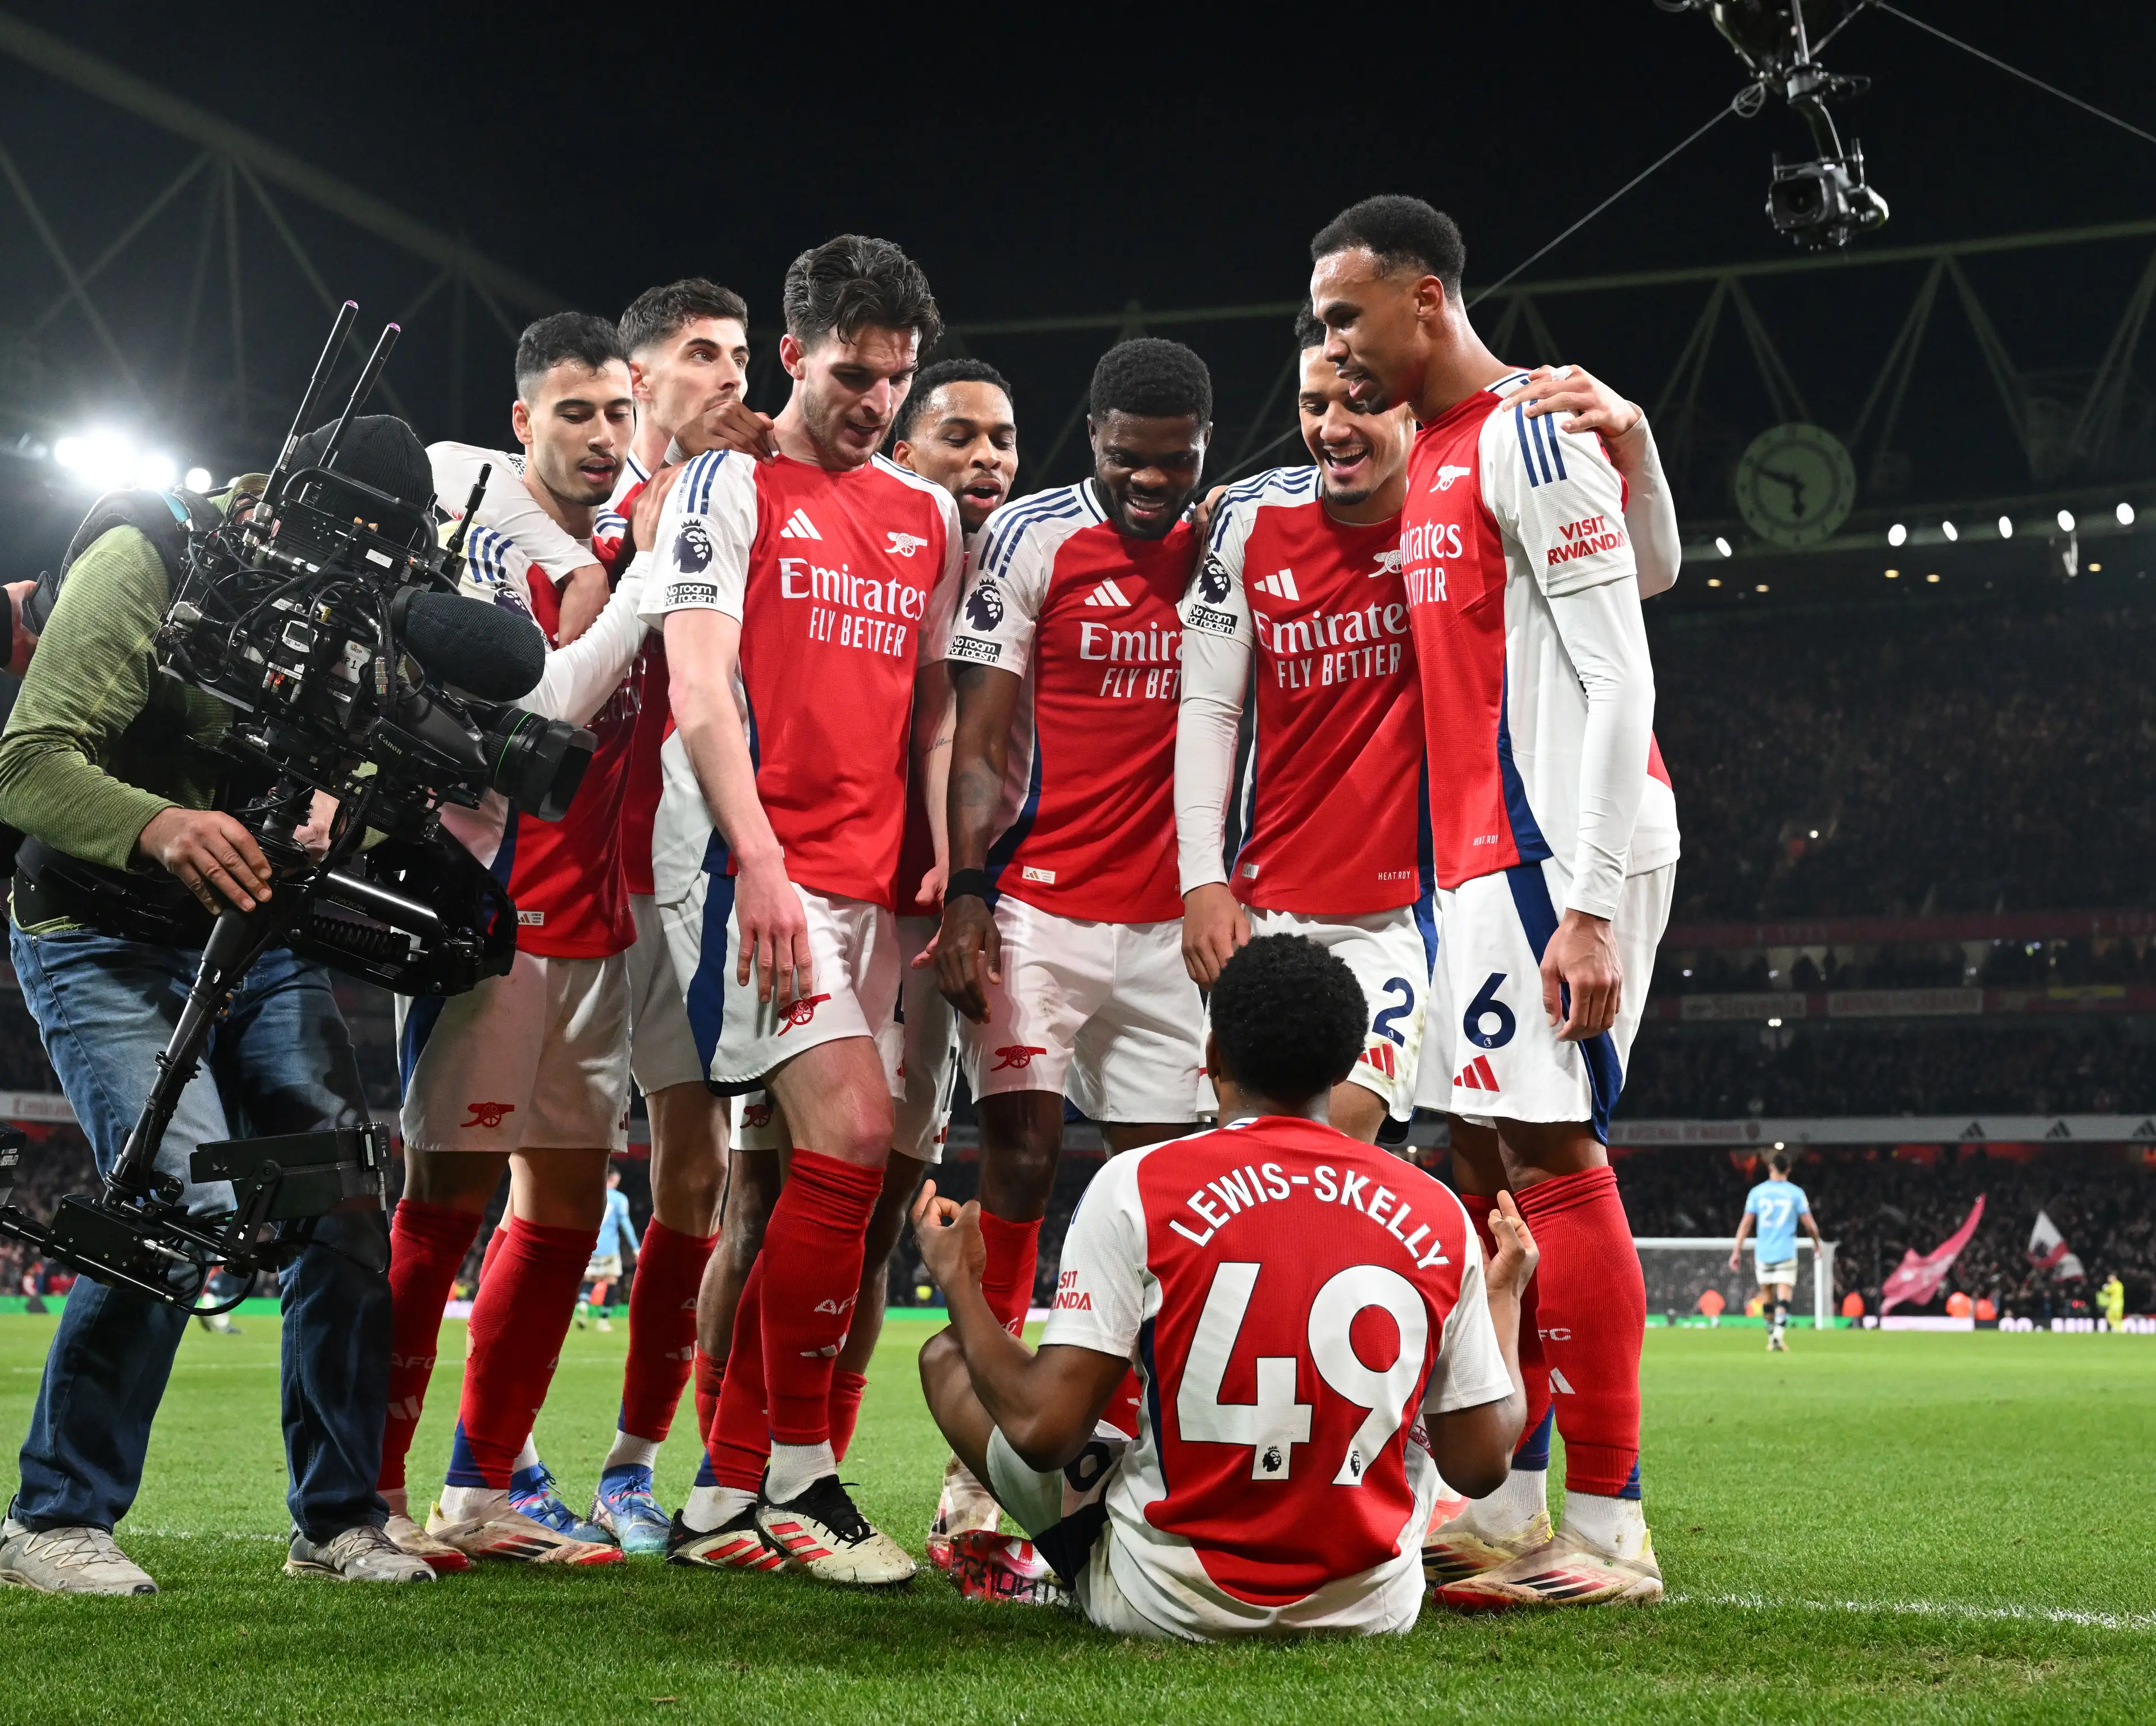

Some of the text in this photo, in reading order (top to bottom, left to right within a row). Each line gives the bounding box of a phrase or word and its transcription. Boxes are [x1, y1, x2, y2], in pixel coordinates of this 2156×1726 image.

[1559, 515, 1605, 540] VISIT
[1546, 531, 1626, 565] RWANDA
[664, 593, 716, 606] for racism
[665, 585, 711, 596] No room
[778, 558, 926, 621] Emirates
[1186, 613, 1234, 634] for racism
[1190, 604, 1231, 624] No room
[1253, 601, 1412, 654] Emirate
[809, 606, 907, 657] FLY BETTER
[952, 636, 995, 653] No room
[948, 645, 998, 663] for racism
[1277, 643, 1401, 688] FLY BETTER
[1099, 668, 1141, 698] FLY
[378, 733, 402, 755] Canon
[1473, 834, 1499, 846] HEAT.RDY
[1378, 870, 1411, 881] HEAT.RDY
[1372, 976, 1415, 1048] 2
[1463, 972, 1516, 1049] 6
[1168, 1162, 1450, 1270] LEWIS-SKELLY
[1758, 1197, 1792, 1229] 27
[1176, 1261, 1429, 1486] 49
[1483, 1541, 1495, 1549] MAYA
